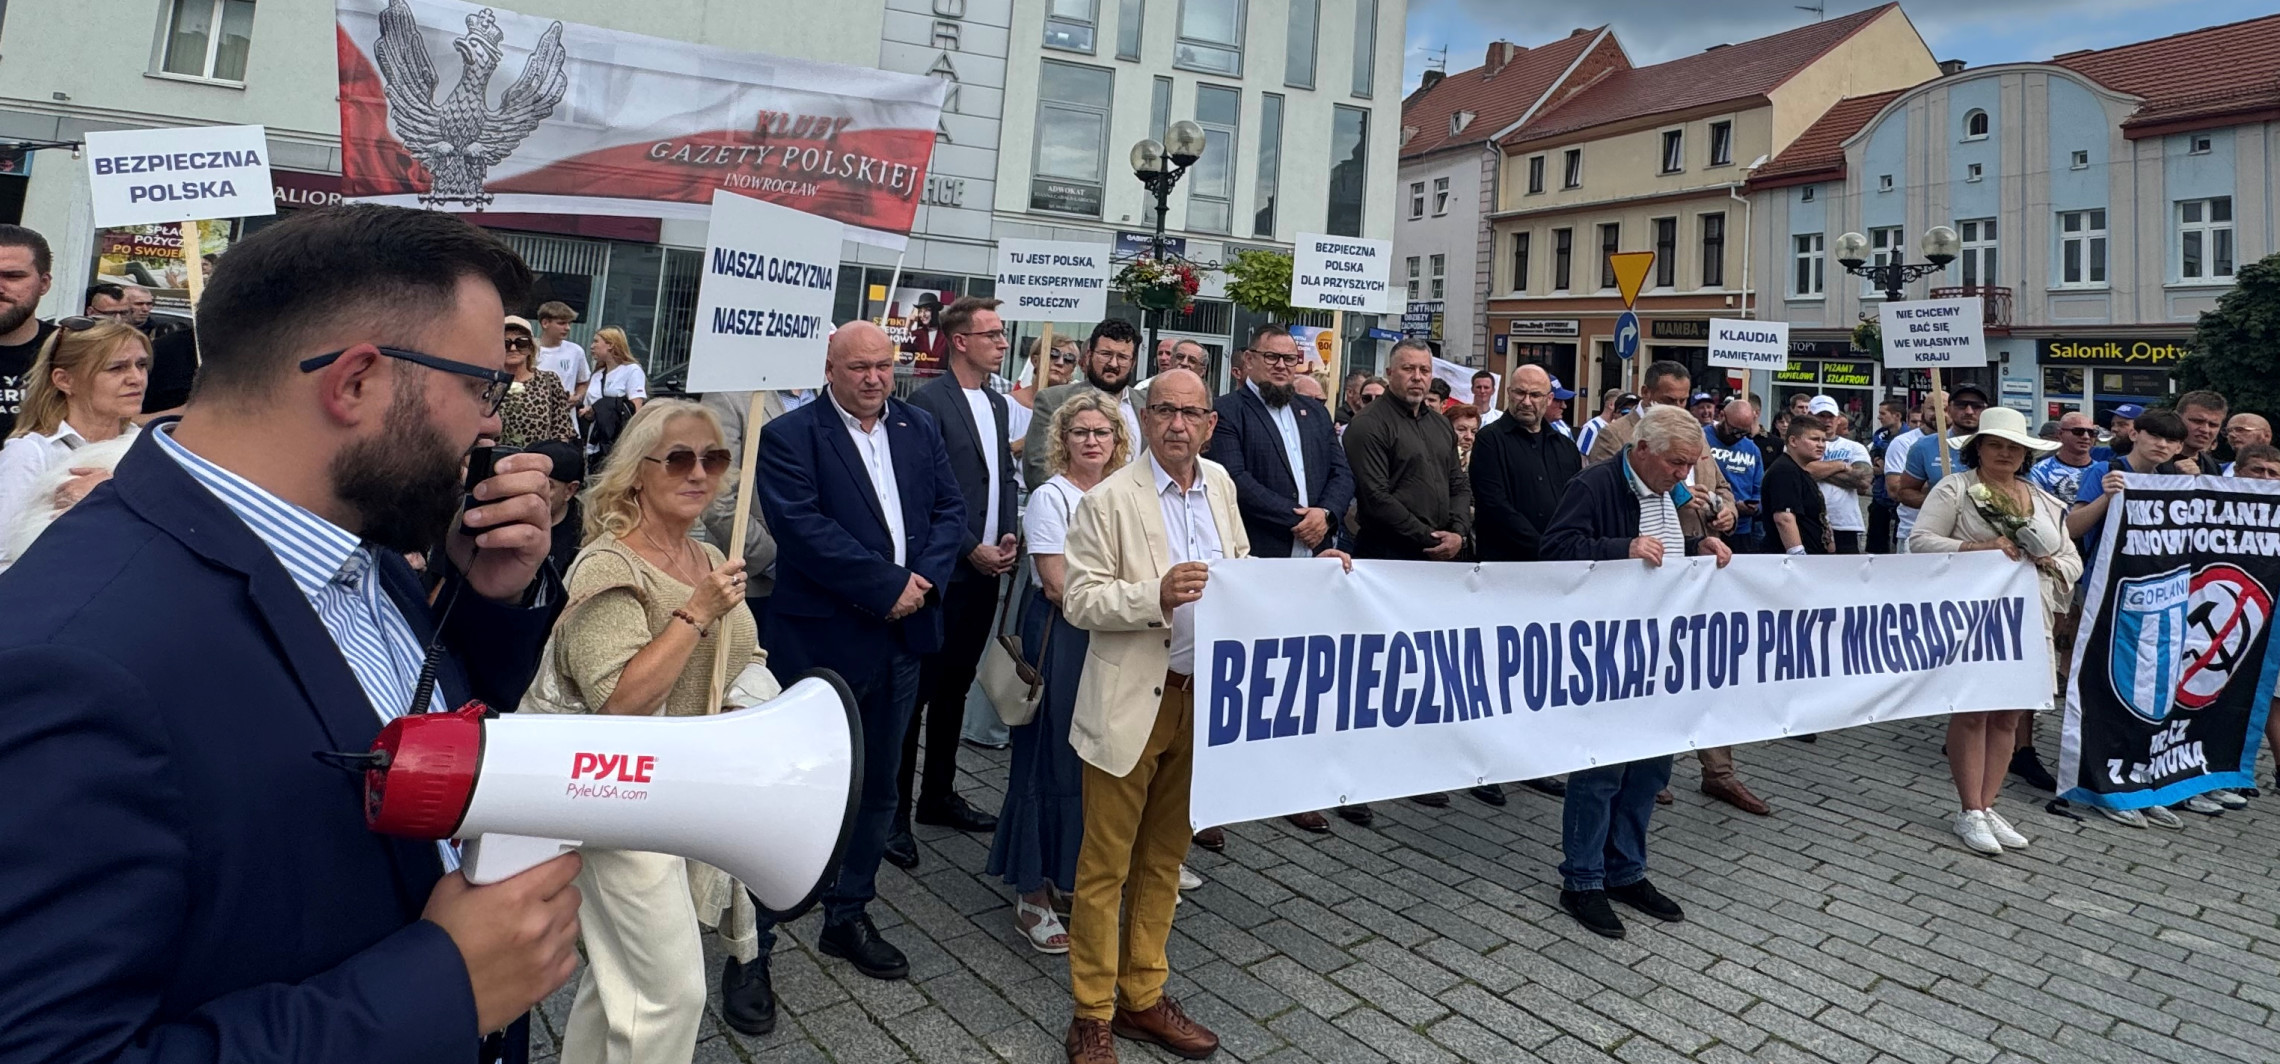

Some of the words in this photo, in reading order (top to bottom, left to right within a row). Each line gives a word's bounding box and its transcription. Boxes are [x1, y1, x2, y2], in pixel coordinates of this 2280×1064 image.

[757, 110, 851, 140] KLUBY
[94, 150, 262, 175] BEZPIECZNA
[650, 141, 774, 165] GAZETY
[781, 146, 918, 197] POLSKIEJ
[130, 180, 237, 203] POLSKA
[723, 172, 820, 197] INOWROCŁAW
[1047, 185, 1086, 196] ADWOKAT
[273, 186, 342, 206] ALIOR
[112, 244, 131, 254] PO
[1315, 242, 1376, 258] BEZPIECZNA
[1010, 252, 1024, 264] TU
[1025, 253, 1051, 265] JEST
[1052, 255, 1095, 269] POLSKA,
[1325, 260, 1364, 273] POLSKA
[712, 247, 764, 281] NASZA
[768, 257, 833, 291] OJCZYZNA
[997, 273, 1006, 284] A
[1007, 274, 1026, 285] NIE
[1028, 275, 1104, 289] EKSPERYMENT
[1300, 275, 1321, 287] DLA
[1322, 277, 1385, 292] PRZYSZŁYCH
[1019, 296, 1080, 309] SPOŁECZNY
[1319, 293, 1365, 307] POKOLEŃ
[1408, 303, 1444, 313] ENTRUM
[1896, 310, 1913, 319] NIE
[1915, 306, 1960, 318] CHCEMY
[712, 307, 764, 336] NASZE
[1655, 322, 1699, 336] MAMBA
[1909, 321, 1931, 333] BAĆ
[1932, 322, 1949, 333] SIĘ
[1719, 329, 1778, 344] KLAUDIA
[1894, 339, 1911, 348] WE
[1912, 336, 1969, 347] WŁASNYM
[1712, 349, 1783, 363] PAMIĘTAMY!
[1915, 352, 1950, 362] KRAJU
[2050, 342, 2123, 359] Salonik
[1826, 374, 1869, 384] SZLAFROKI
[2002, 367, 2009, 376] 8
[2129, 578, 2188, 605] GOPLANI
[1207, 626, 1494, 748] BEZPIECZNA
[1496, 617, 1660, 715] POLSKA!
[1664, 611, 1749, 695] STOP
[1757, 608, 1837, 684] PAKT
[1841, 596, 2025, 676] MIGRACYJNY
[571, 752, 654, 783] PYLE
[2107, 759, 2125, 784] Z
[566, 783, 648, 800] PyleUSA.com
